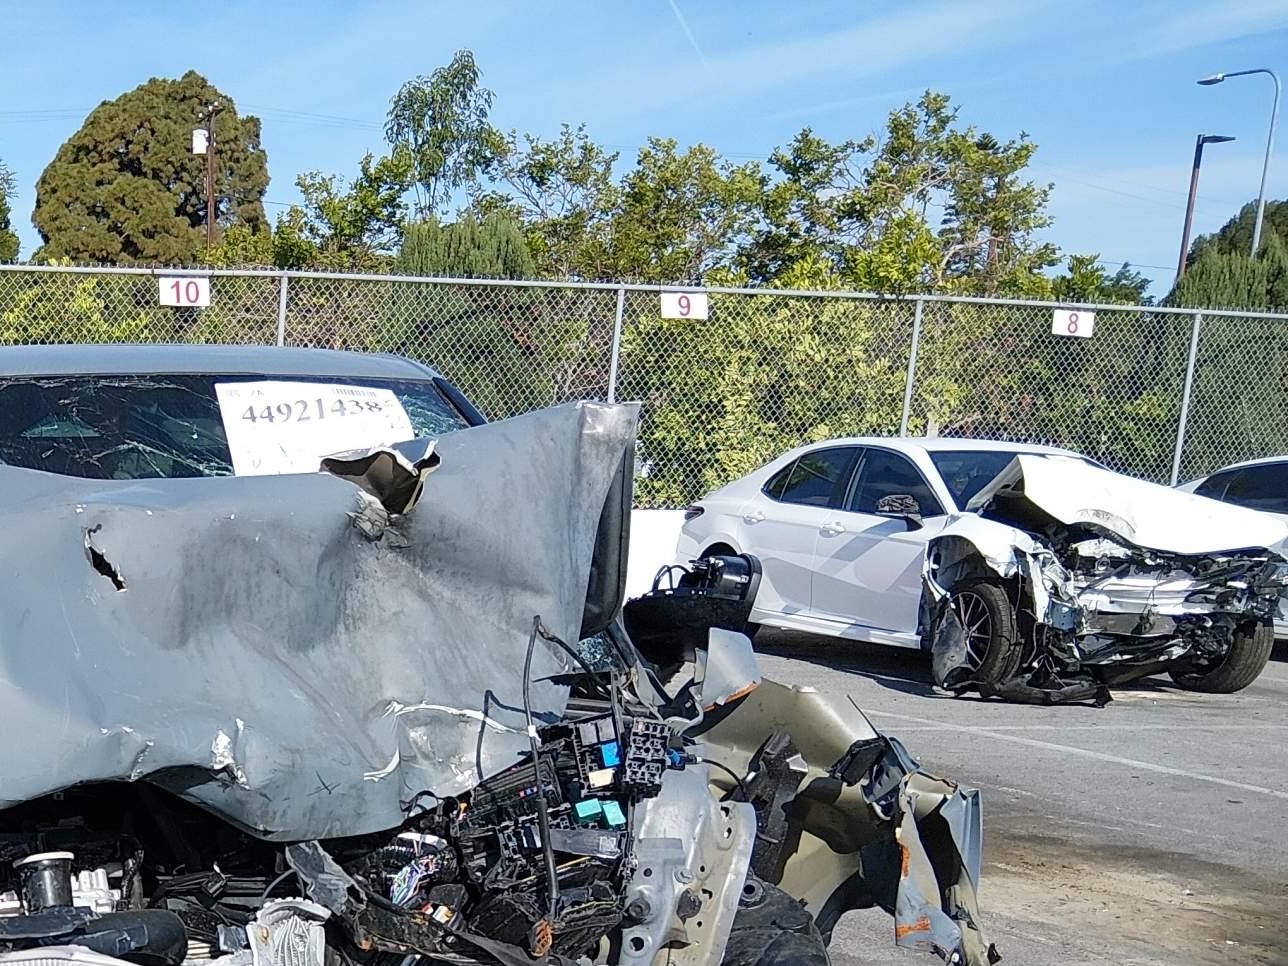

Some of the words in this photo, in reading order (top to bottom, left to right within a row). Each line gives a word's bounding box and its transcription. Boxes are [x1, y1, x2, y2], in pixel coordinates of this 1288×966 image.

[170, 280, 199, 304] 10
[678, 294, 691, 317] 9
[1067, 312, 1079, 334] 8
[241, 398, 383, 424] 44921438
